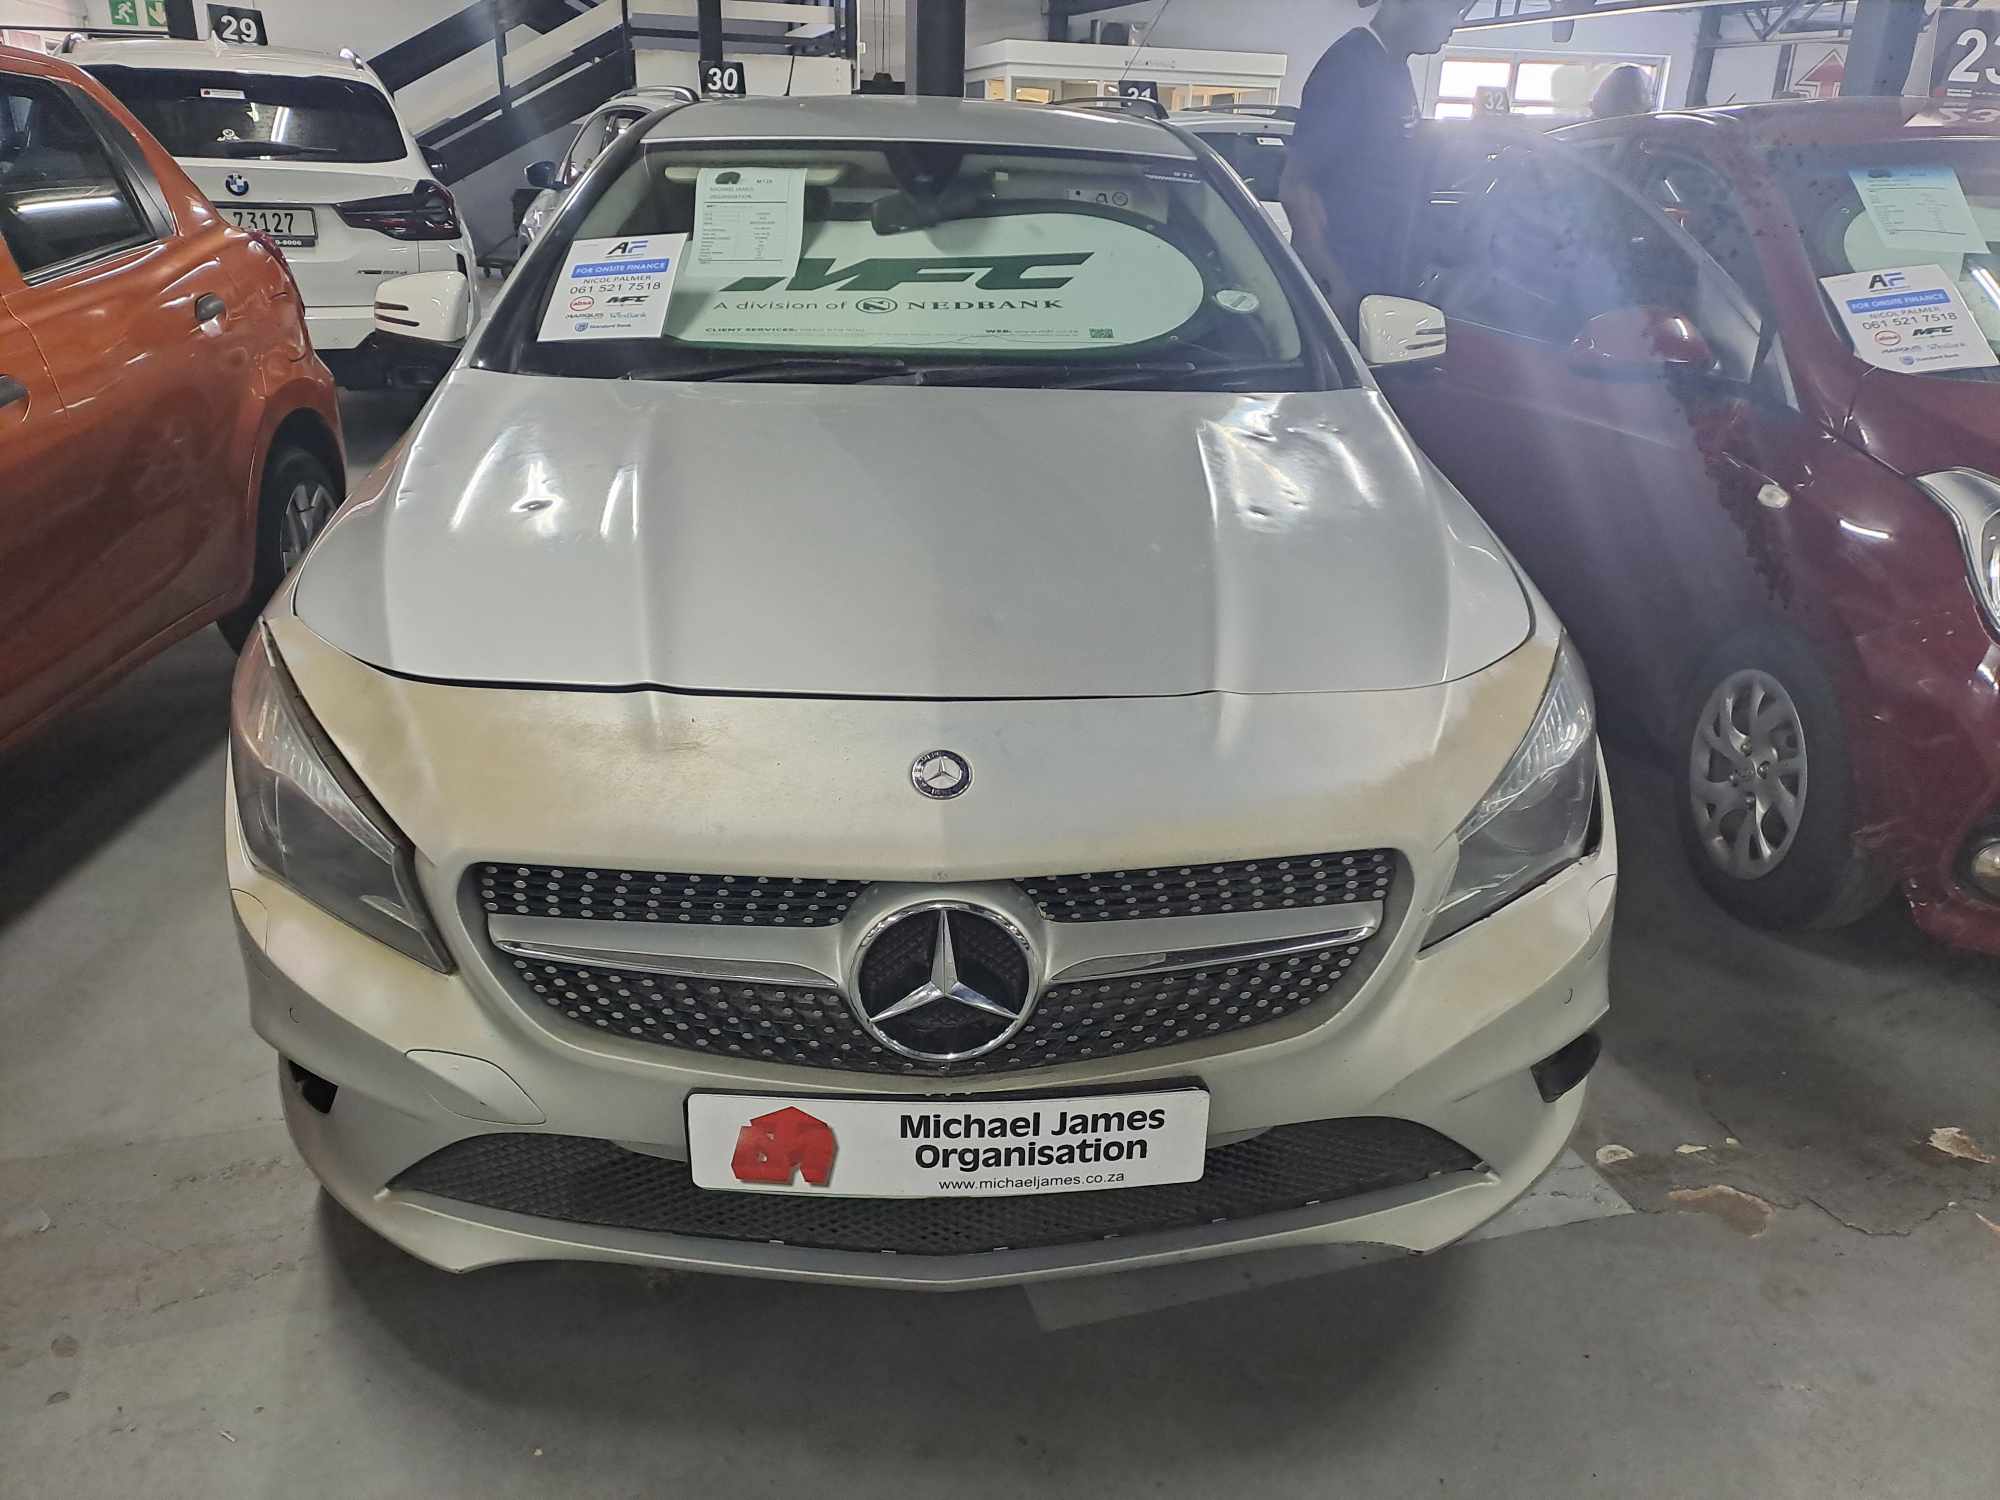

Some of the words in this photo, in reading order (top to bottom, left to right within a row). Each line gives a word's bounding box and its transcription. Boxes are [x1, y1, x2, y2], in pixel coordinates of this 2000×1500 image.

[221, 15, 257, 42] 29
[707, 67, 738, 91] 30
[1485, 91, 1505, 110] 32
[607, 240, 649, 255] AF
[595, 265, 624, 273] ONSITE
[626, 262, 666, 271] FINANCE
[570, 285, 594, 295] 061
[599, 282, 622, 292] 521
[628, 281, 661, 291] 7518
[1869, 272, 1905, 289] AF
[713, 302, 728, 310] A
[736, 300, 818, 310] division
[826, 300, 848, 310] of
[908, 300, 1064, 310] NEDBANK
[1862, 320, 1888, 330] 061
[1893, 316, 1918, 326] 521
[1922, 312, 1958, 322] 7518
[900, 1111, 1041, 1139] Michael
[1051, 1108, 1166, 1136] James
[915, 1138, 1148, 1173] Organisation
[938, 1172, 1125, 1191] www.michaeljames.co.za
